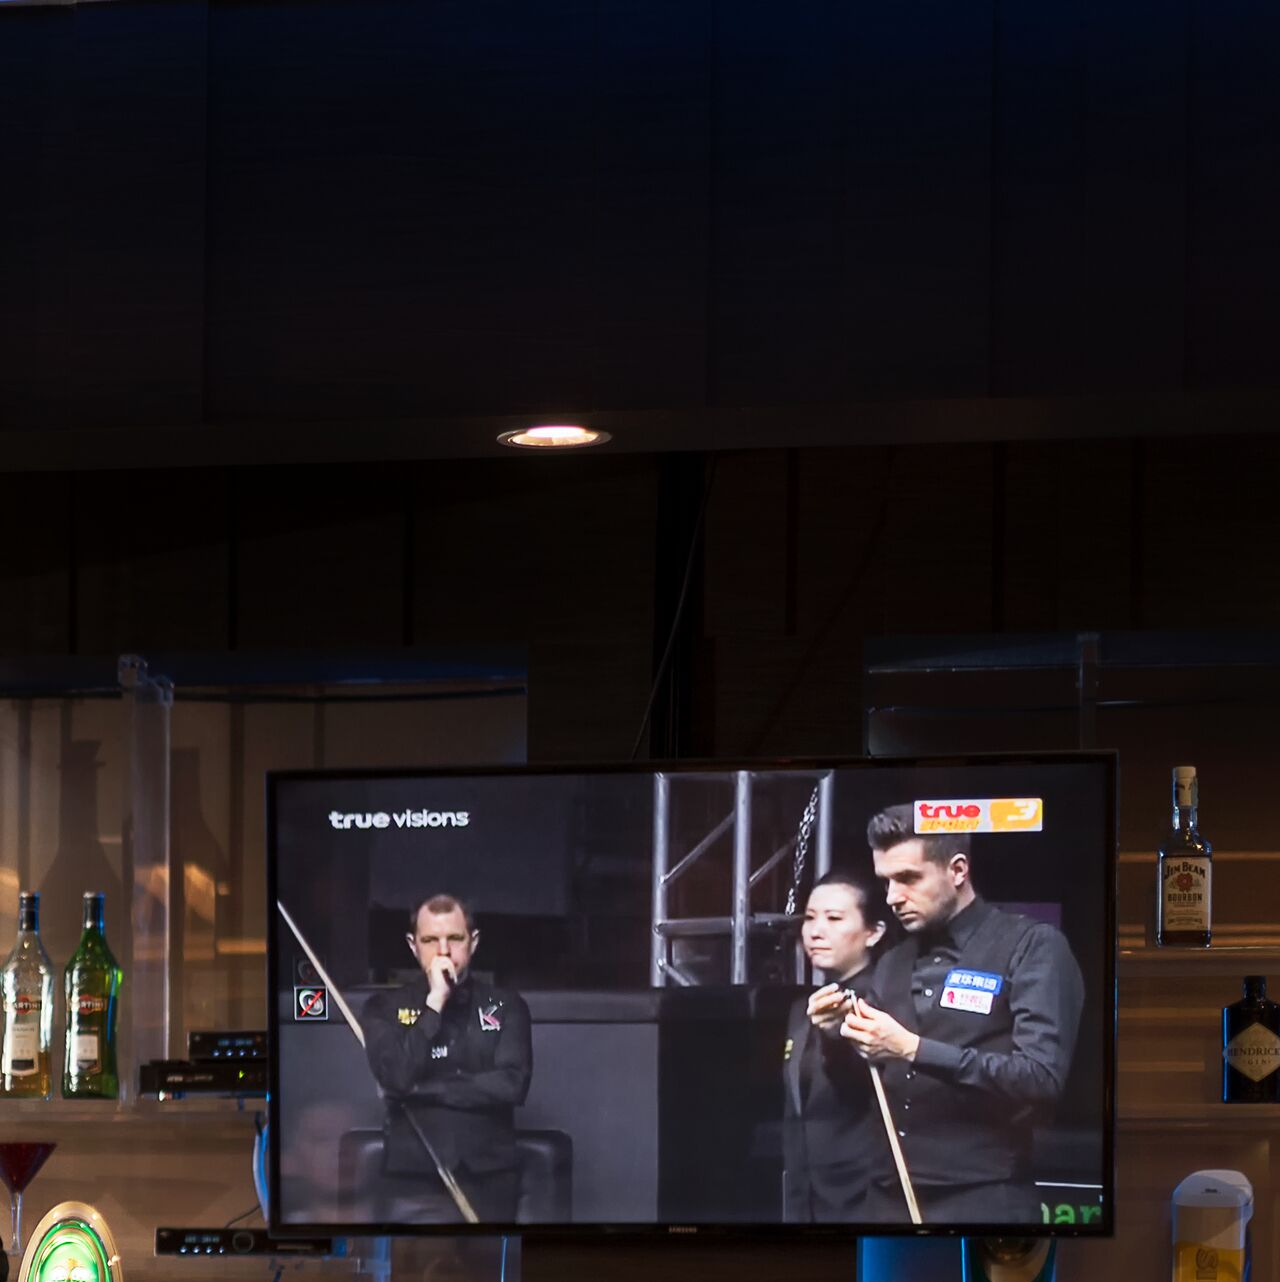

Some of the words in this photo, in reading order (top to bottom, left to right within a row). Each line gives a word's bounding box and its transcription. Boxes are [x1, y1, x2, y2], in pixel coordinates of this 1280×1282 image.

[328, 810, 390, 829] true
[392, 808, 471, 828] visions
[1164, 864, 1181, 879] JIM
[1182, 861, 1206, 879] BEAM
